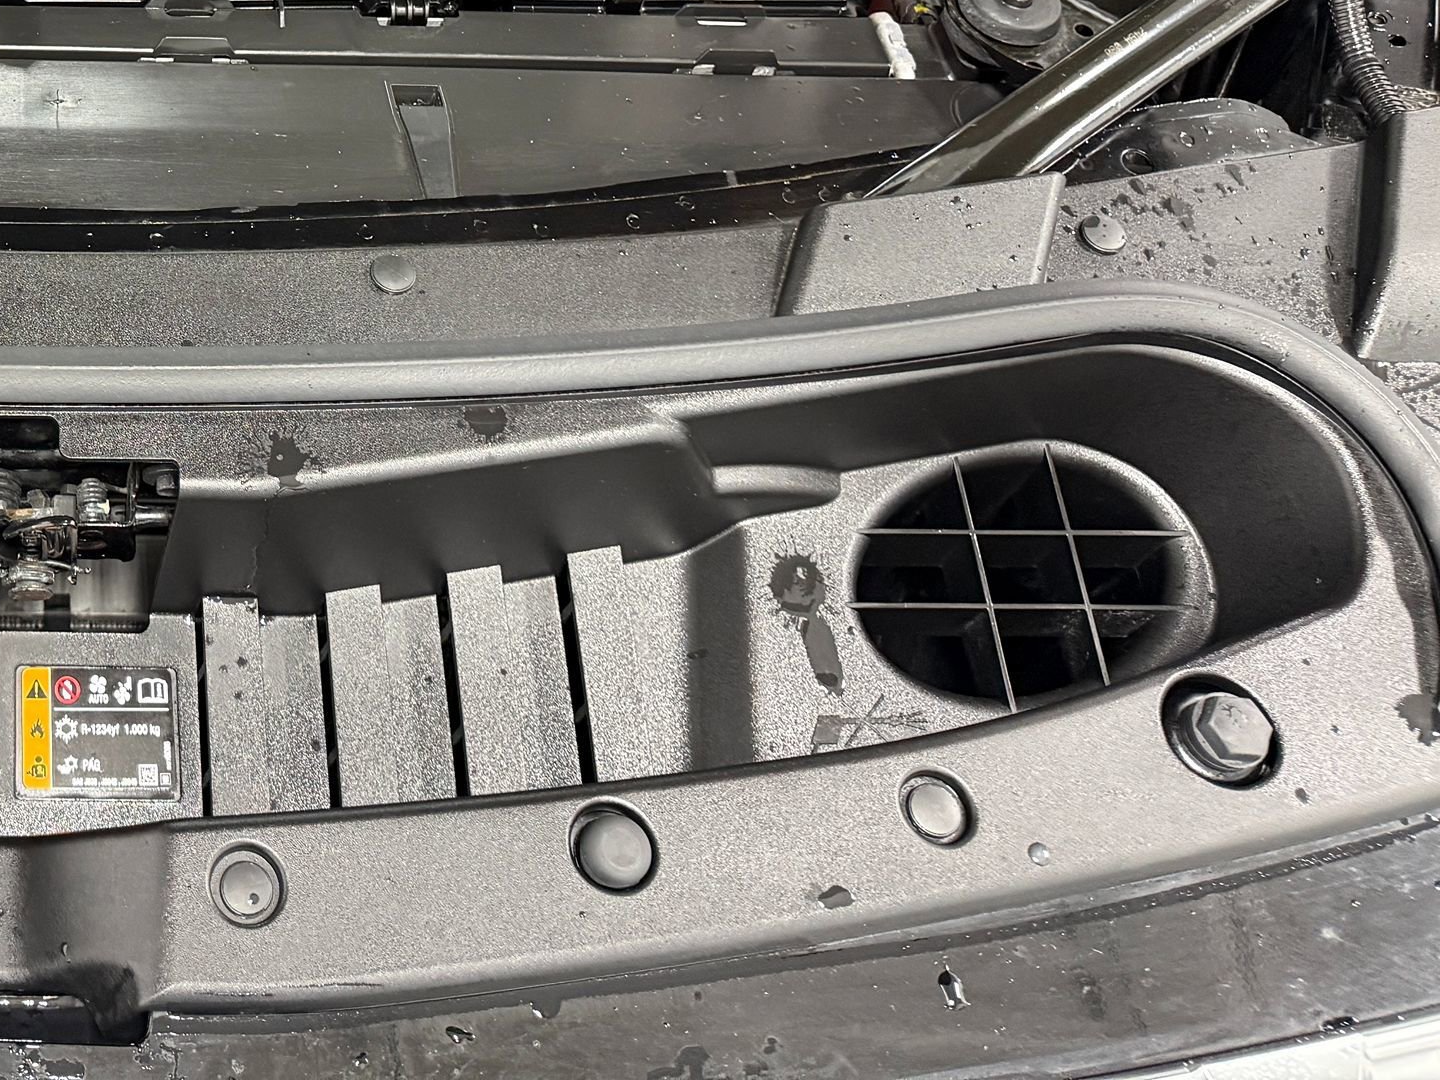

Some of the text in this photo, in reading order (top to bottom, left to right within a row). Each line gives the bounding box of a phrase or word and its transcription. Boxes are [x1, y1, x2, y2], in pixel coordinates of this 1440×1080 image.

[88, 693, 109, 704] AUTO
[123, 724, 148, 735] 1.000
[149, 724, 161, 738] kg
